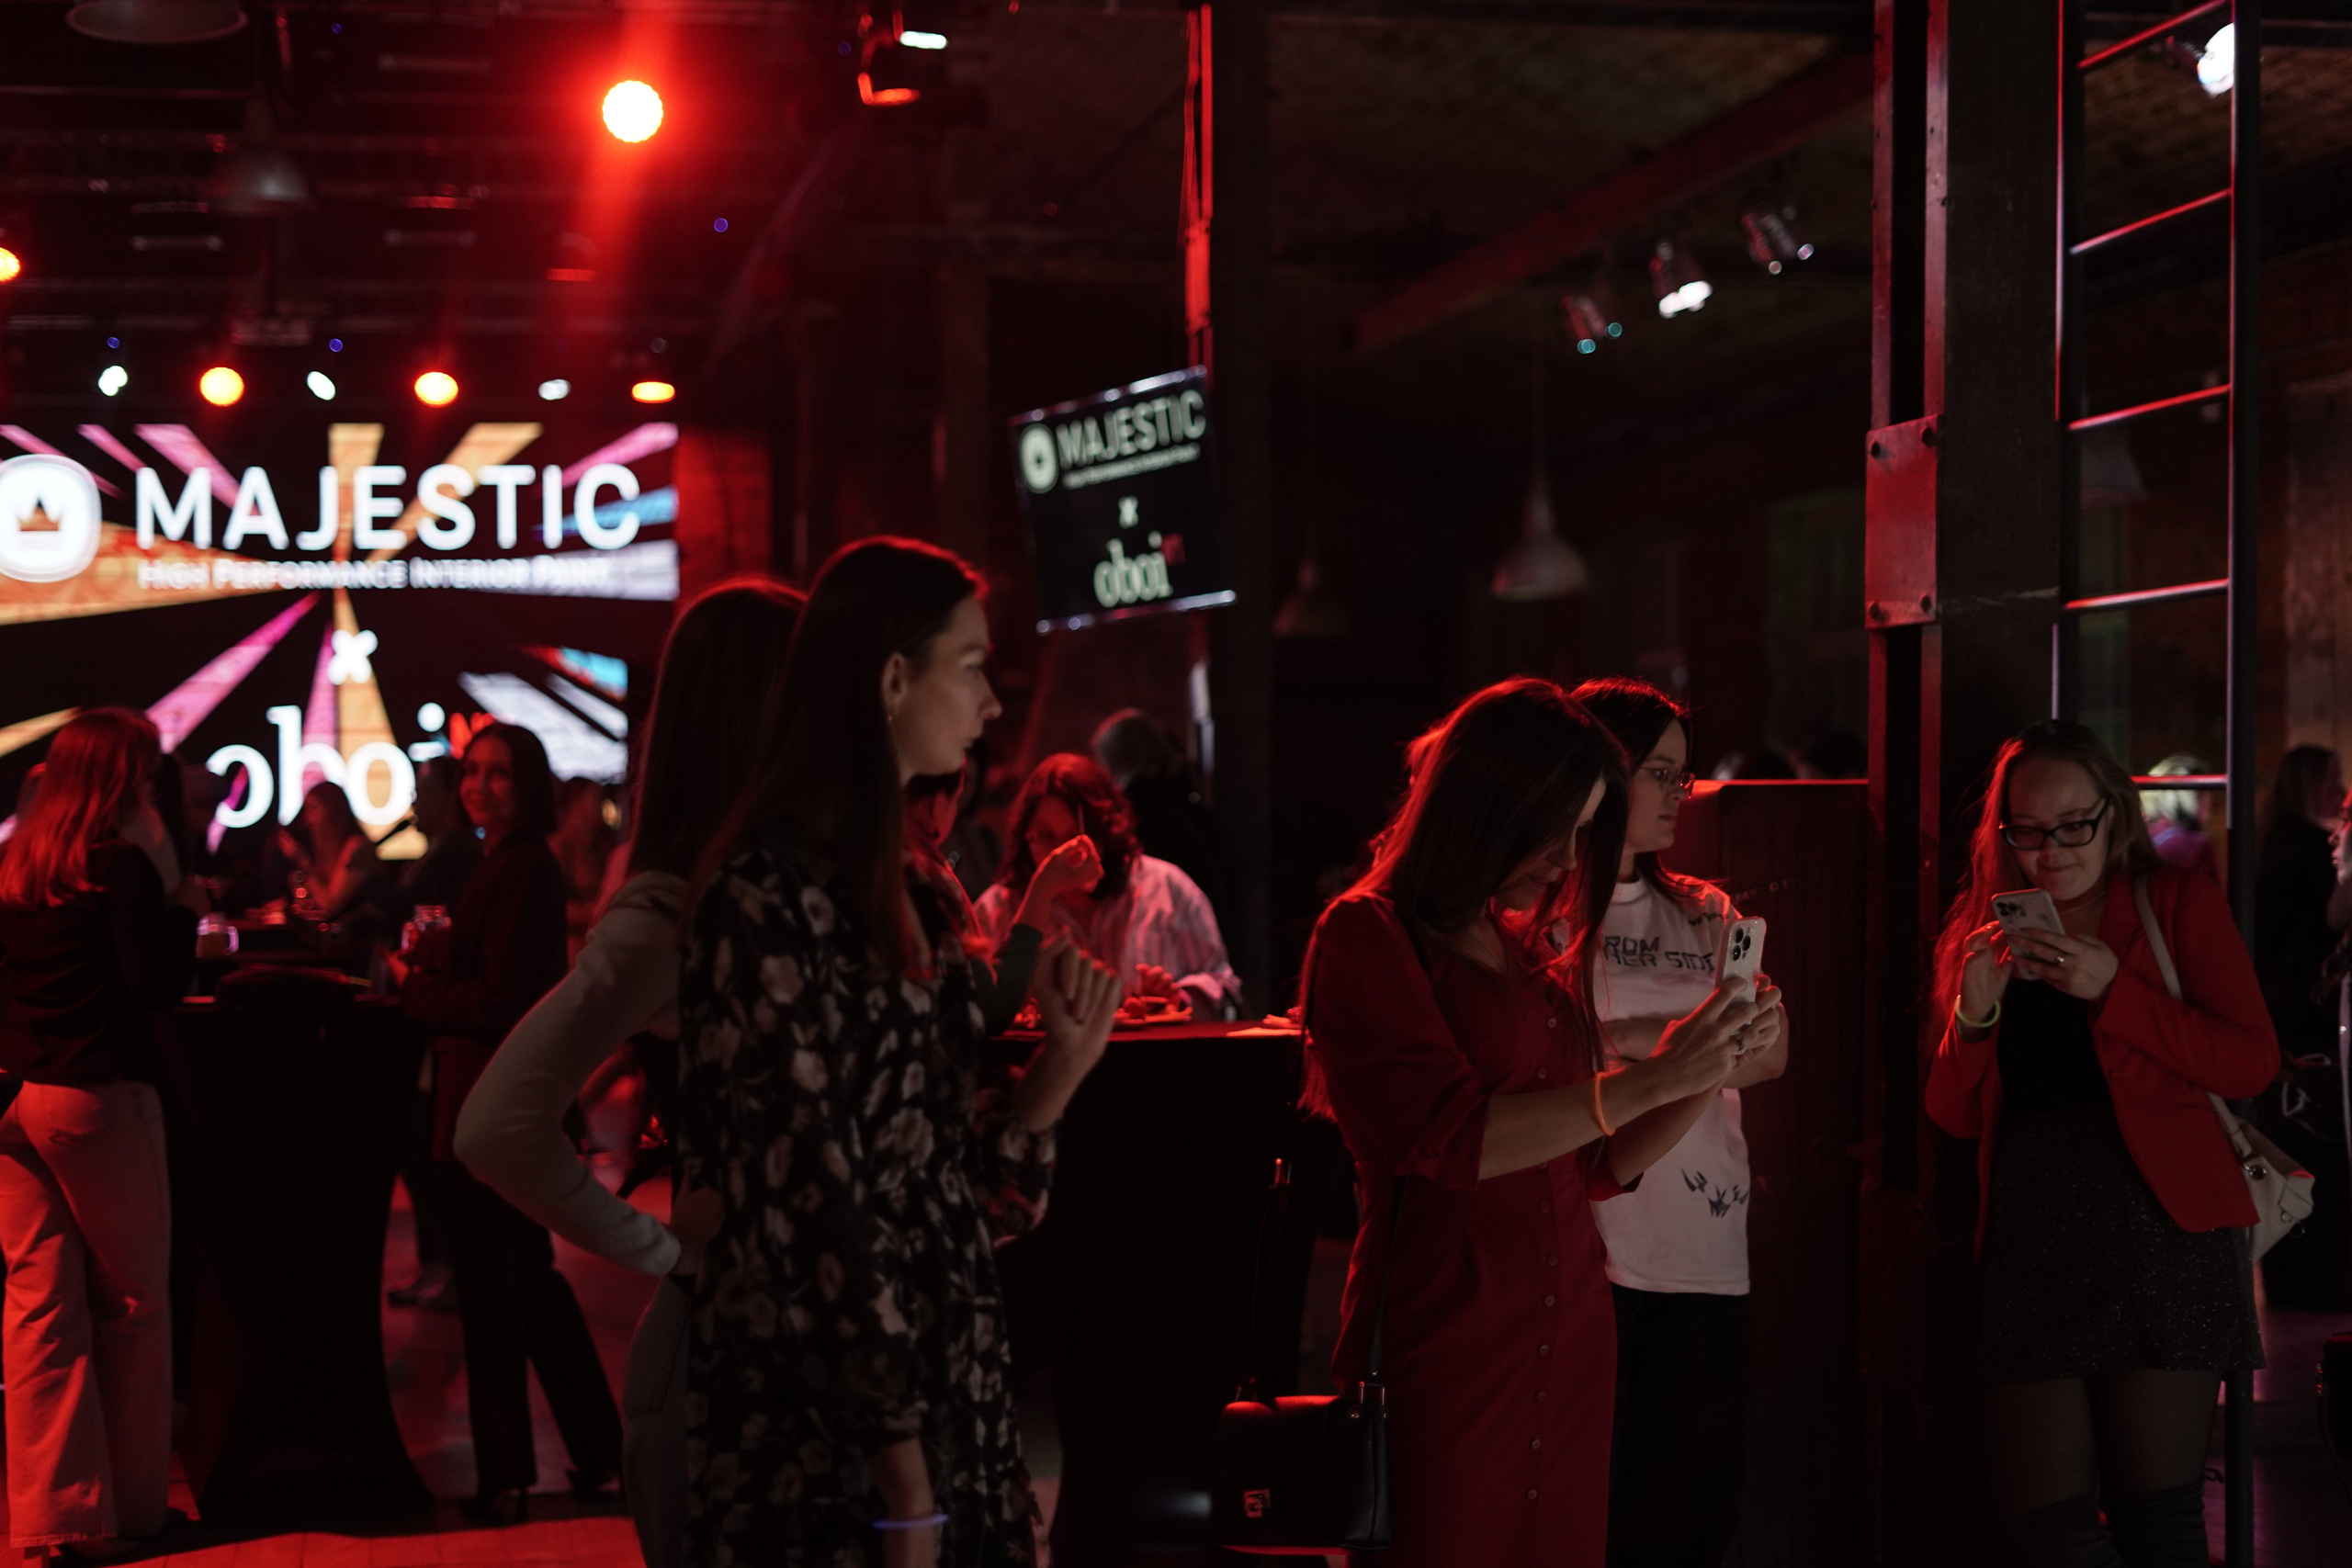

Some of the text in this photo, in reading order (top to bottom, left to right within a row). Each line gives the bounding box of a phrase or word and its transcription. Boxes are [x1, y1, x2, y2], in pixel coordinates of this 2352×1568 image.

[1056, 389, 1206, 470] MAJESTIC
[135, 464, 641, 551] MAJESTIC
[1603, 935, 1660, 956] ROM
